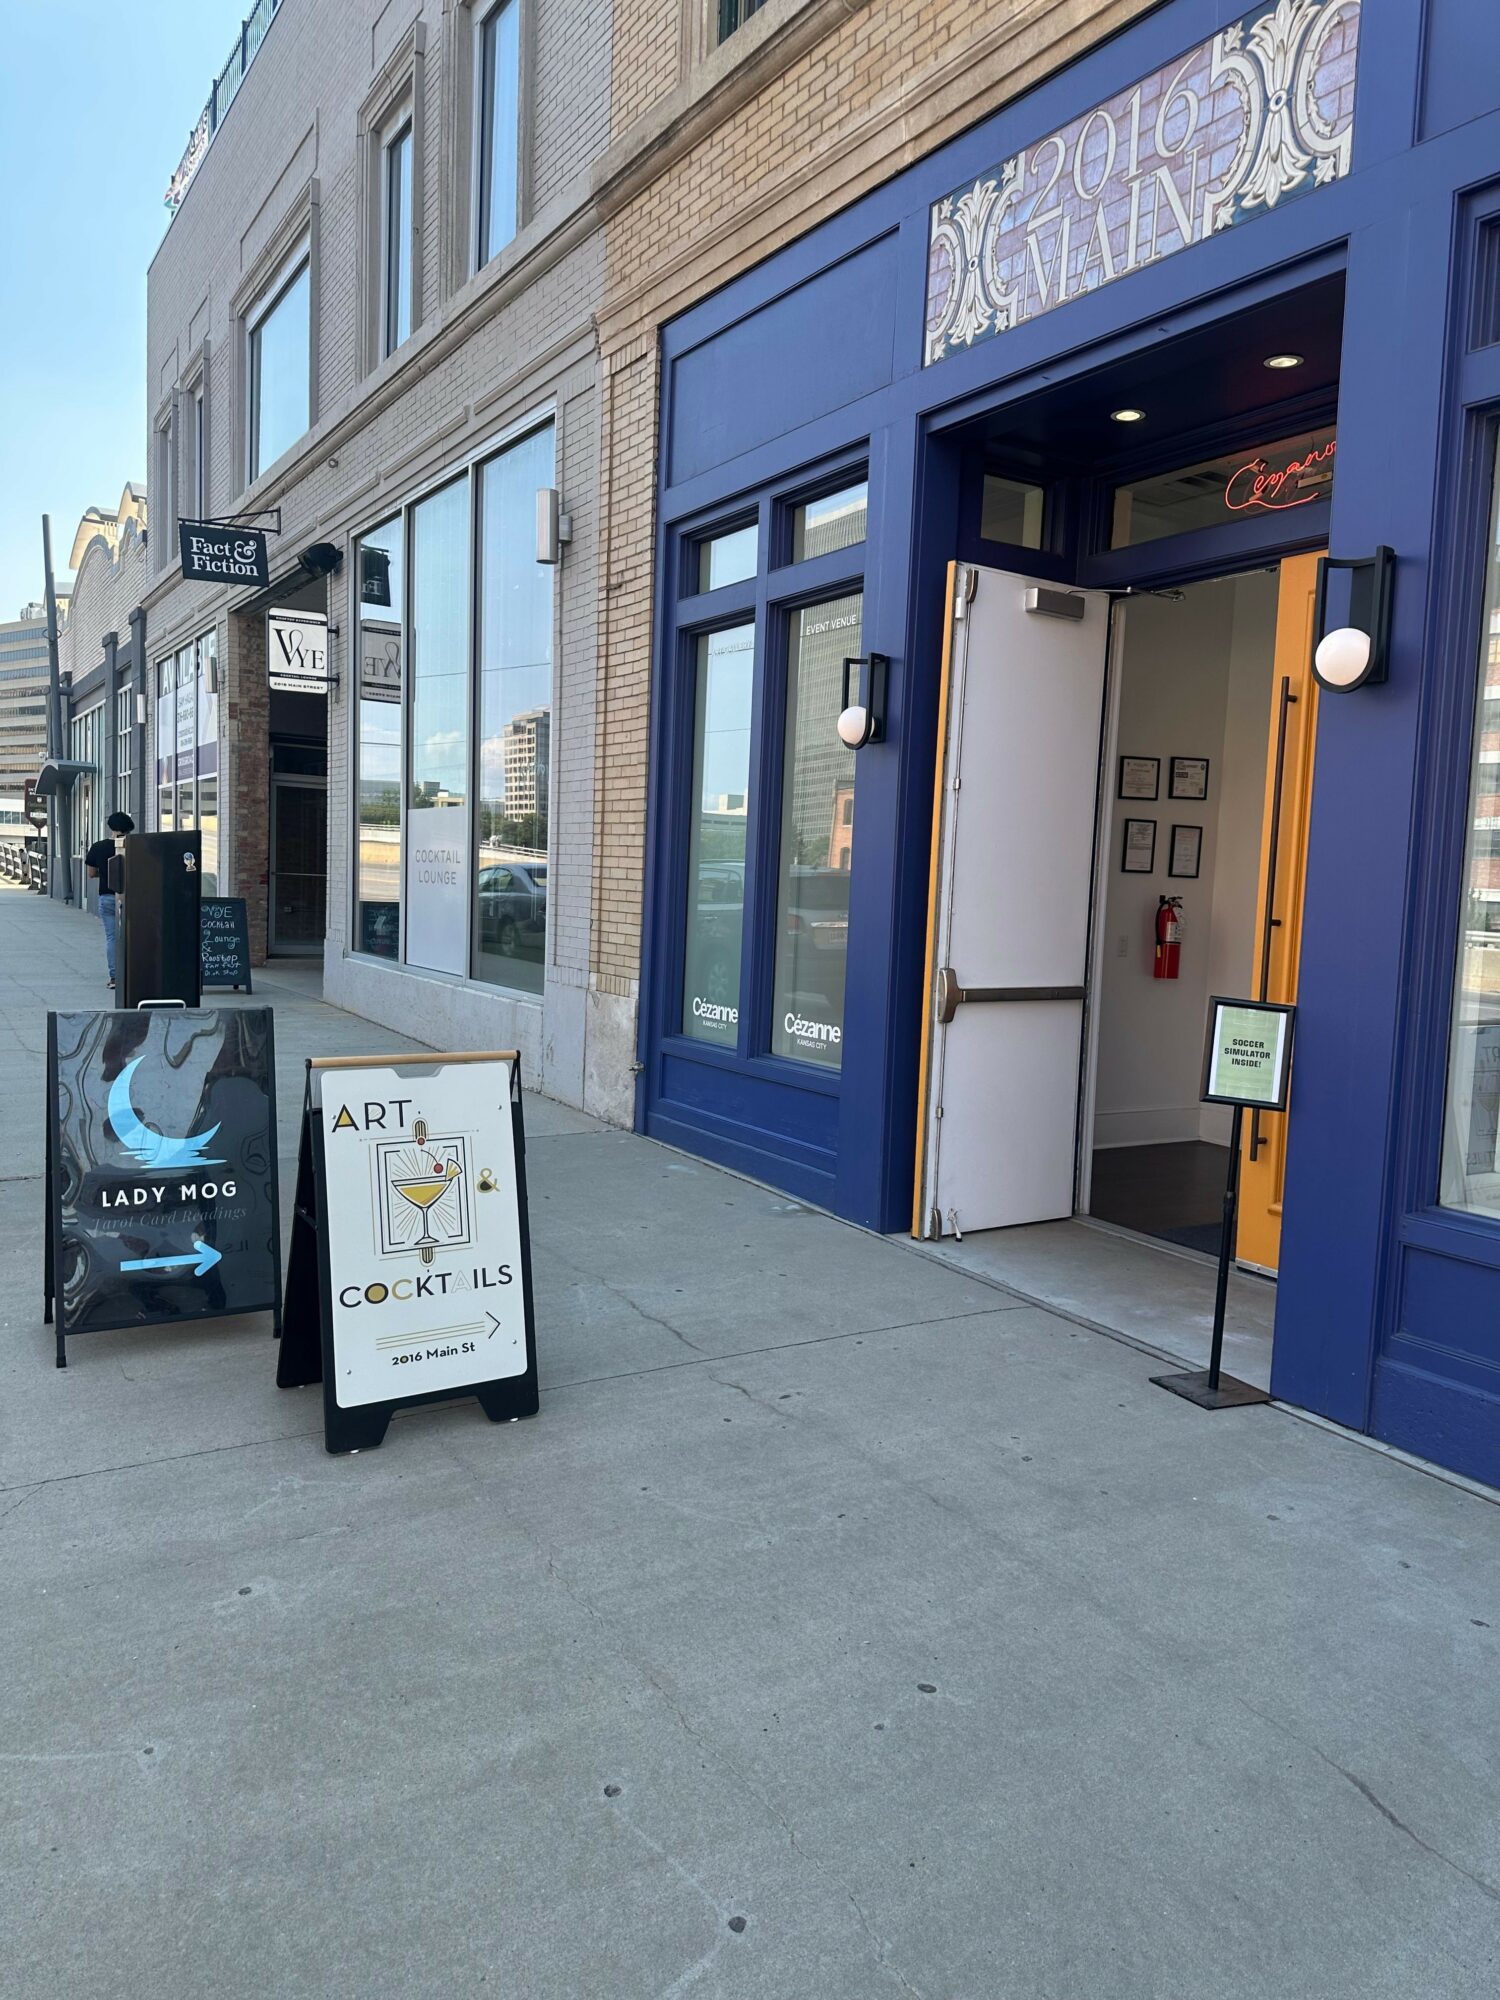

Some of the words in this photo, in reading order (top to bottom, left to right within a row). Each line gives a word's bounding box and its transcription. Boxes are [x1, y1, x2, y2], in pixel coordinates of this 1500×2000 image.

[1028, 50, 1201, 232] 2016
[1019, 144, 1204, 321] MAIN
[189, 536, 232, 556] Fact
[233, 540, 258, 563] &
[191, 554, 259, 576] Fiction
[806, 620, 830, 635] EVENT
[830, 614, 857, 629] VENUE
[415, 850, 461, 864] COCKTAIL
[418, 870, 457, 885] LOUNGE
[692, 997, 738, 1023] Cézanne
[702, 1020, 718, 1029] KANSAS
[718, 1023, 727, 1031] CITY
[784, 1012, 841, 1043] Cézanne
[797, 1038, 815, 1048] KANSAS
[815, 1041, 827, 1050] CITY
[1224, 1047, 1271, 1059] SIMULATOR
[1232, 1038, 1265, 1049] SOCCER
[1231, 1058, 1262, 1068] INSIDE!
[331, 1099, 413, 1133] ART
[476, 1167, 500, 1194] &
[102, 1186, 166, 1208] LADY
[181, 1181, 237, 1201] MOG
[92, 1217, 135, 1232] Tarot
[140, 1210, 177, 1226] Card
[182, 1206, 247, 1223] Readings
[339, 1264, 513, 1308] COCKTAILS
[392, 1351, 423, 1366] 2016
[426, 1344, 458, 1360] Main
[461, 1341, 476, 1353] St
